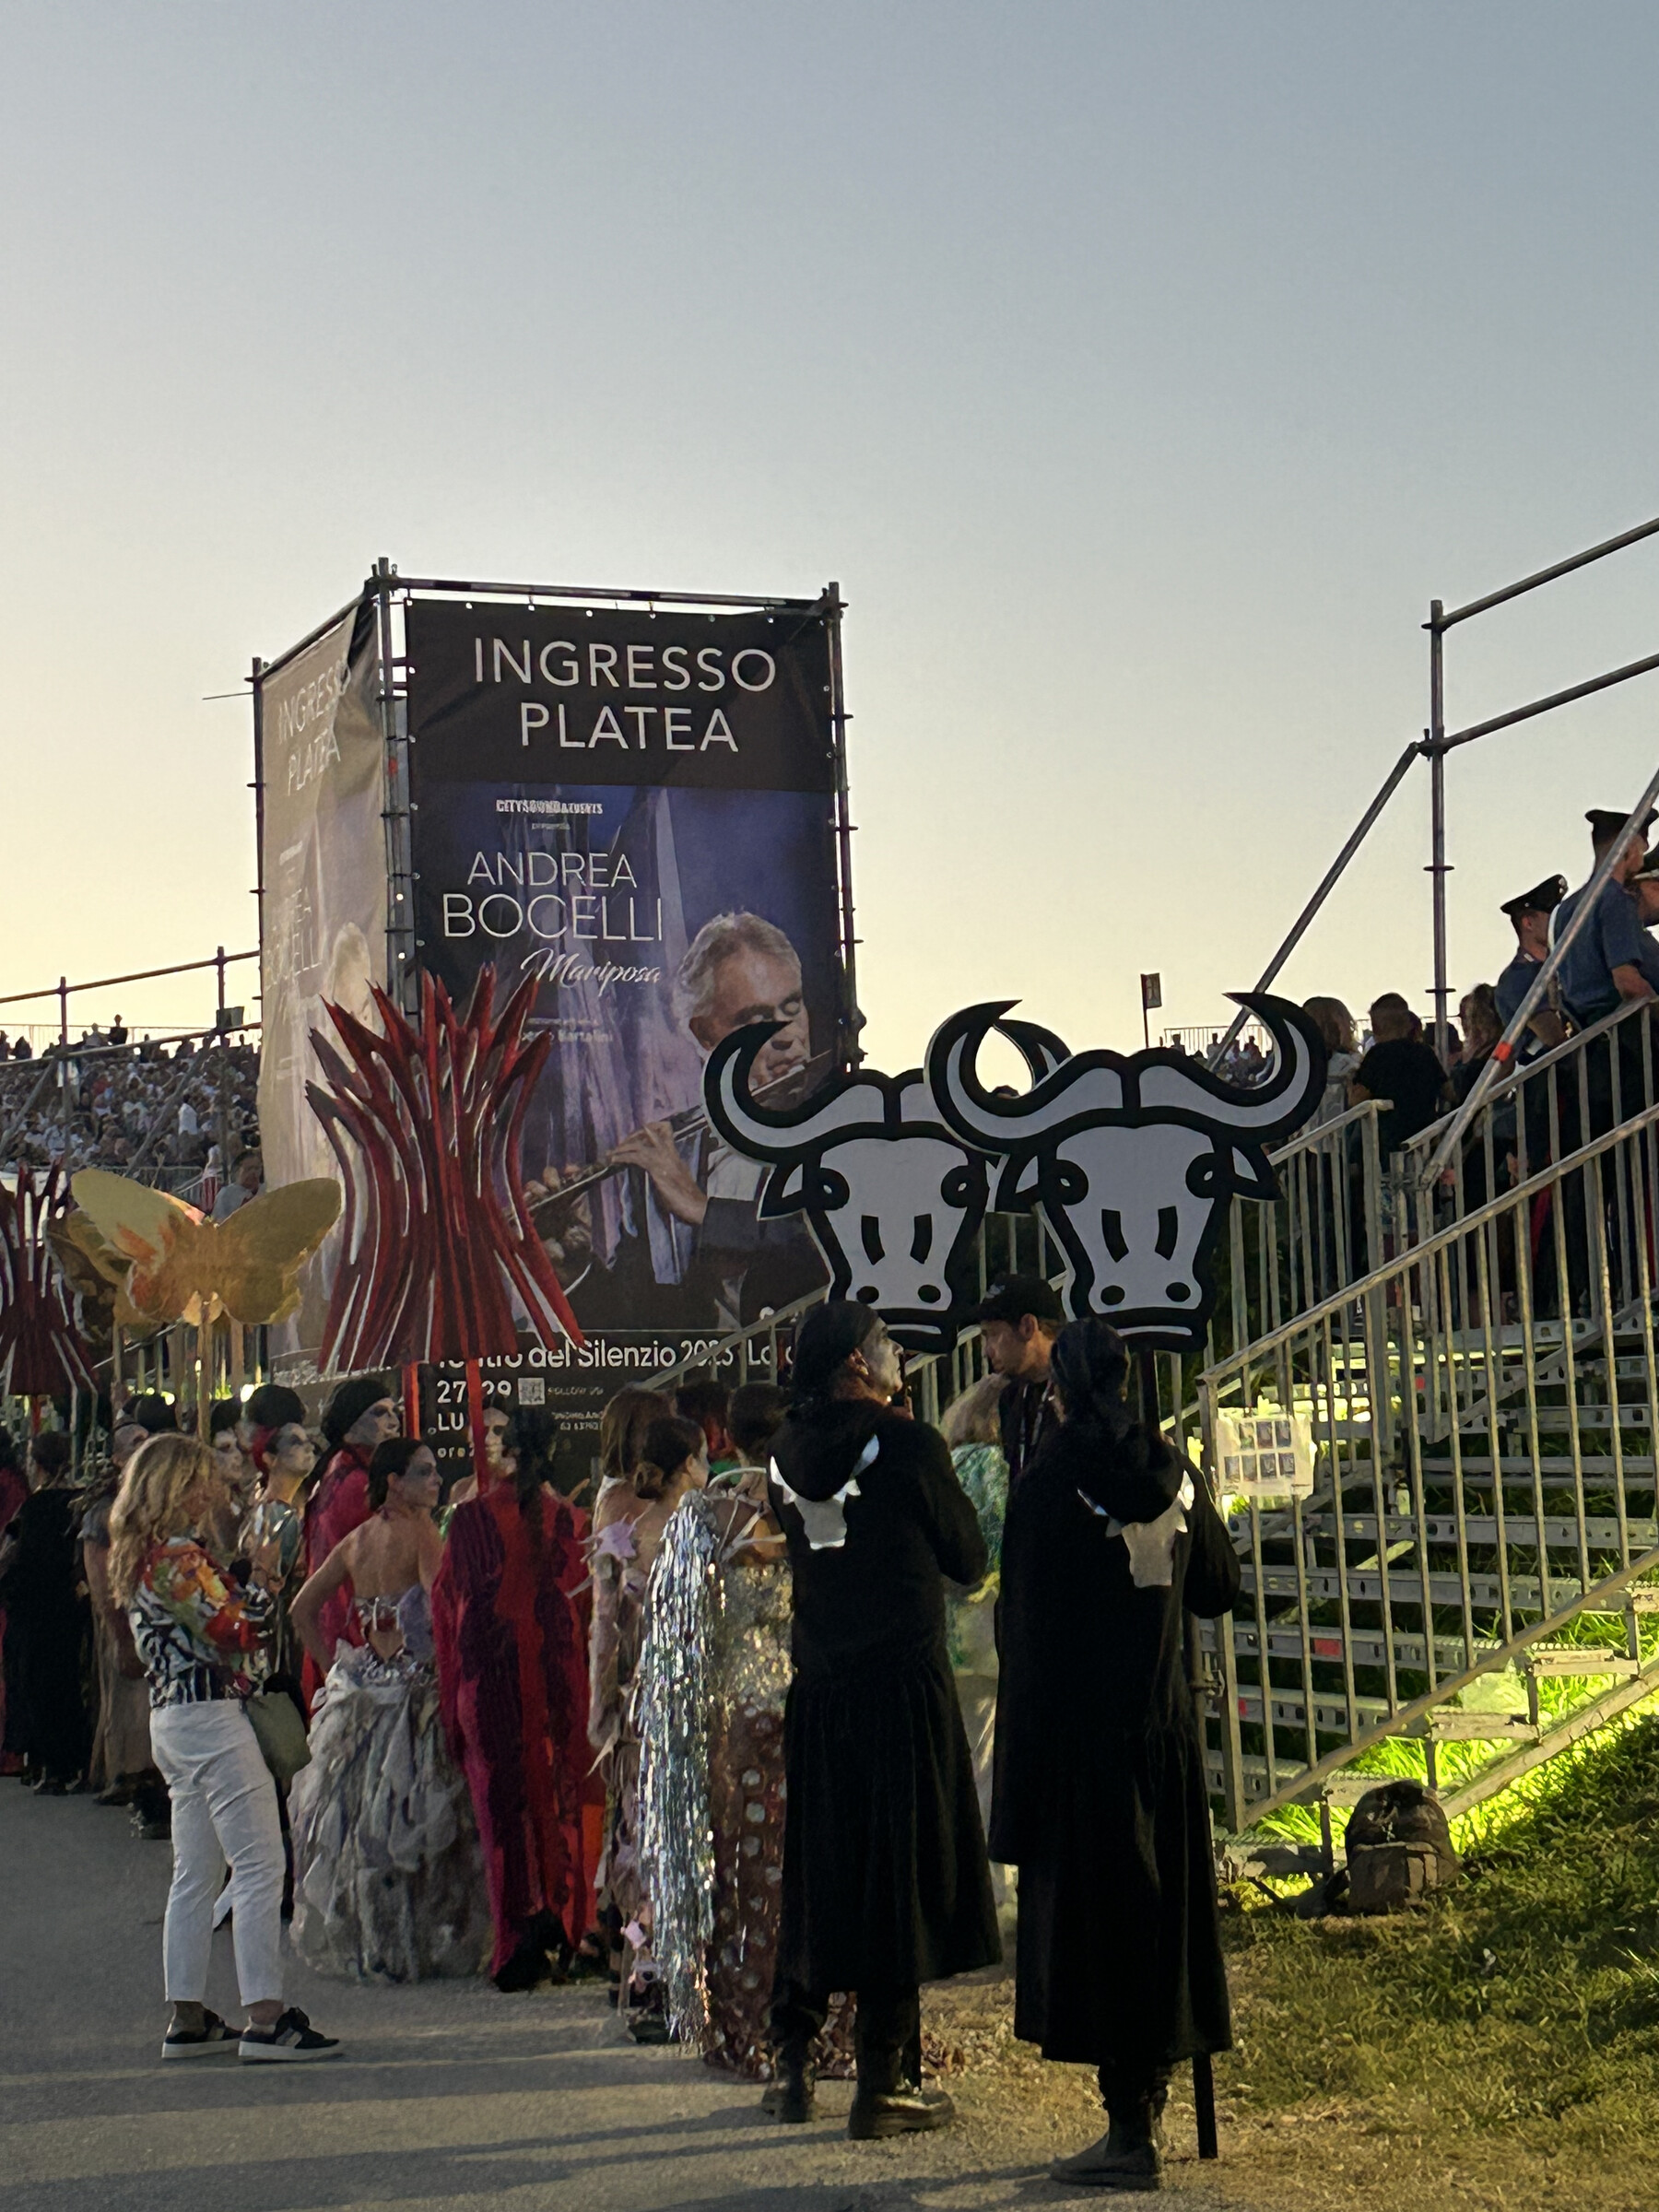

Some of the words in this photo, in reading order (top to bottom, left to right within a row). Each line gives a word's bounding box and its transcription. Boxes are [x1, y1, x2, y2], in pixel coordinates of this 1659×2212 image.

[475, 637, 776, 692] INGRESSO
[520, 702, 739, 752] PLATEA
[467, 851, 638, 888] ANDREA
[442, 893, 662, 941] BOCELLI
[520, 947, 661, 997] Mariposa
[578, 1339, 677, 1368] Silenzio
